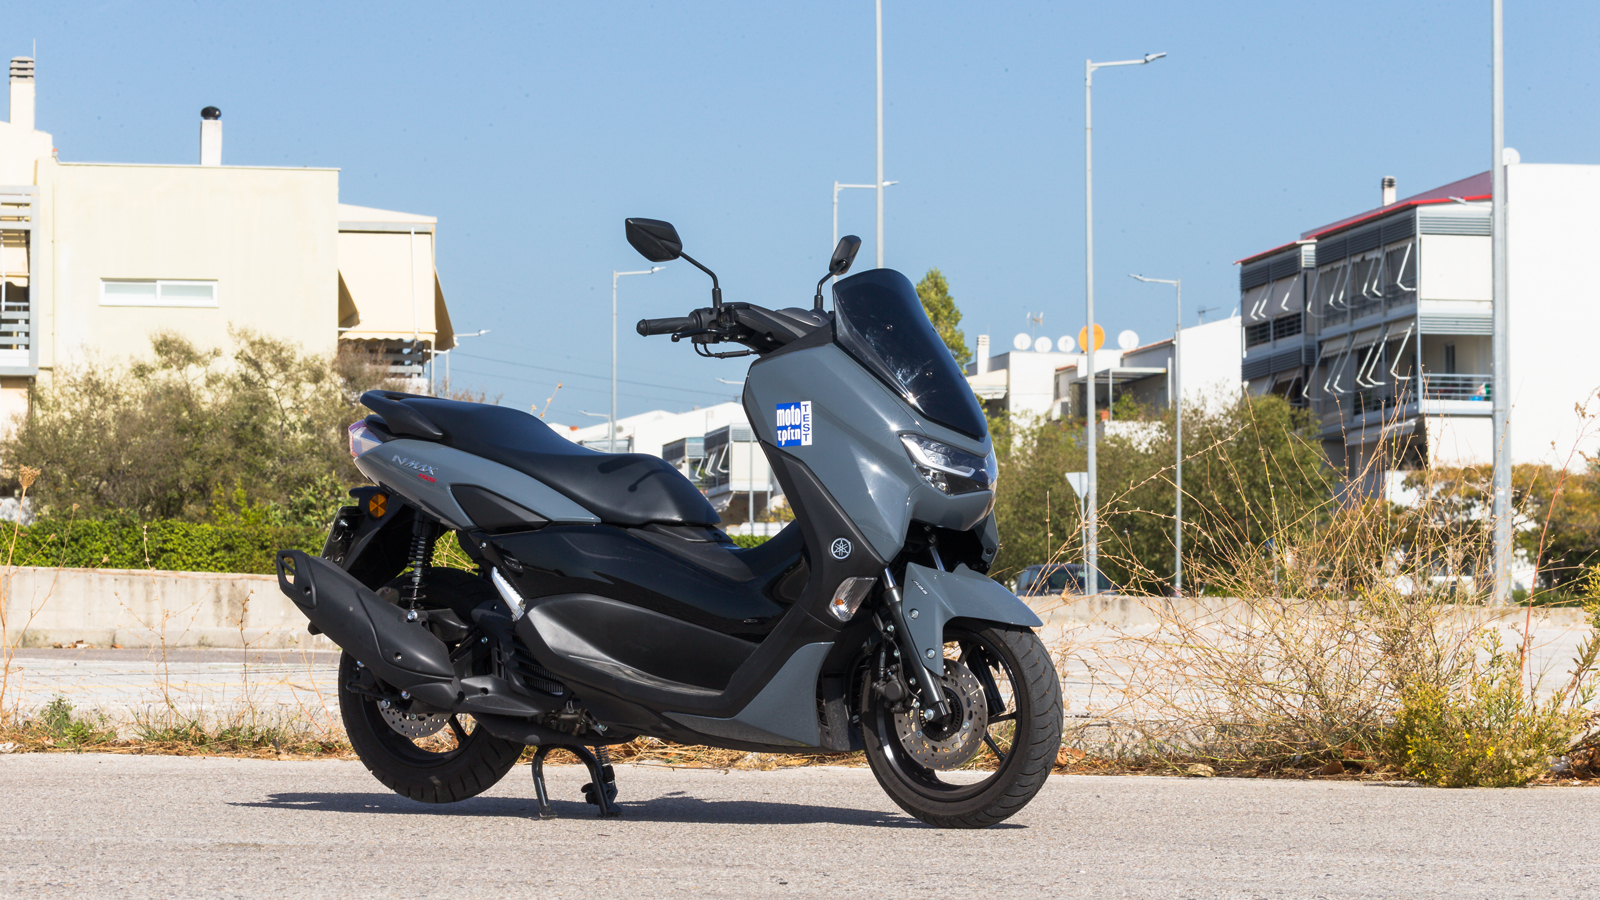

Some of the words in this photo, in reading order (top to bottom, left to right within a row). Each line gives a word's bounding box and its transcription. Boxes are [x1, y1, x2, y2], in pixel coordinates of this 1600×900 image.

[777, 404, 801, 427] moto
[802, 403, 811, 442] TEST
[391, 454, 439, 476] NMAX
